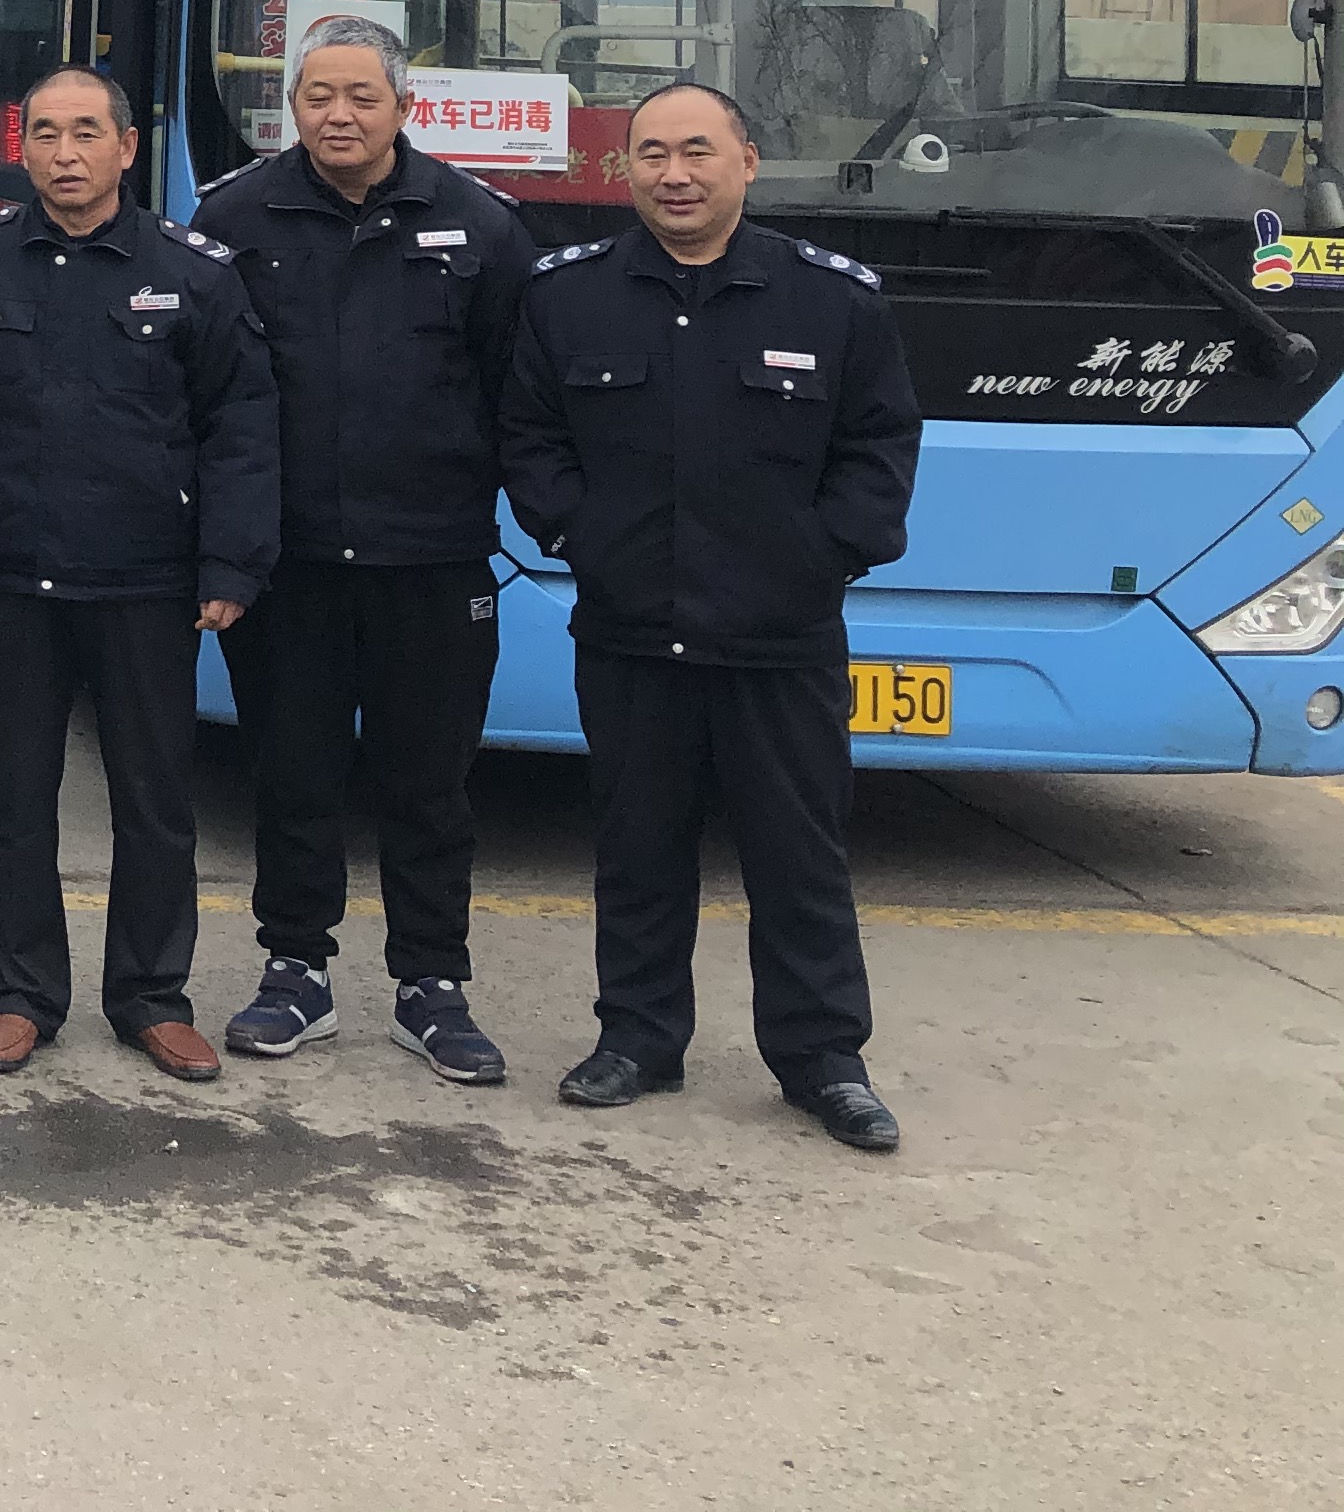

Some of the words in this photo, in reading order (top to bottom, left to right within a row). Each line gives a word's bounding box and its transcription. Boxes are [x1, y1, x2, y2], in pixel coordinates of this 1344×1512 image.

[411, 97, 553, 133] 本车已消毒
[1076, 337, 1235, 376] 新能源
[967, 375, 1060, 395] new
[1068, 376, 1207, 414] energy
[1290, 509, 1317, 524] LNG
